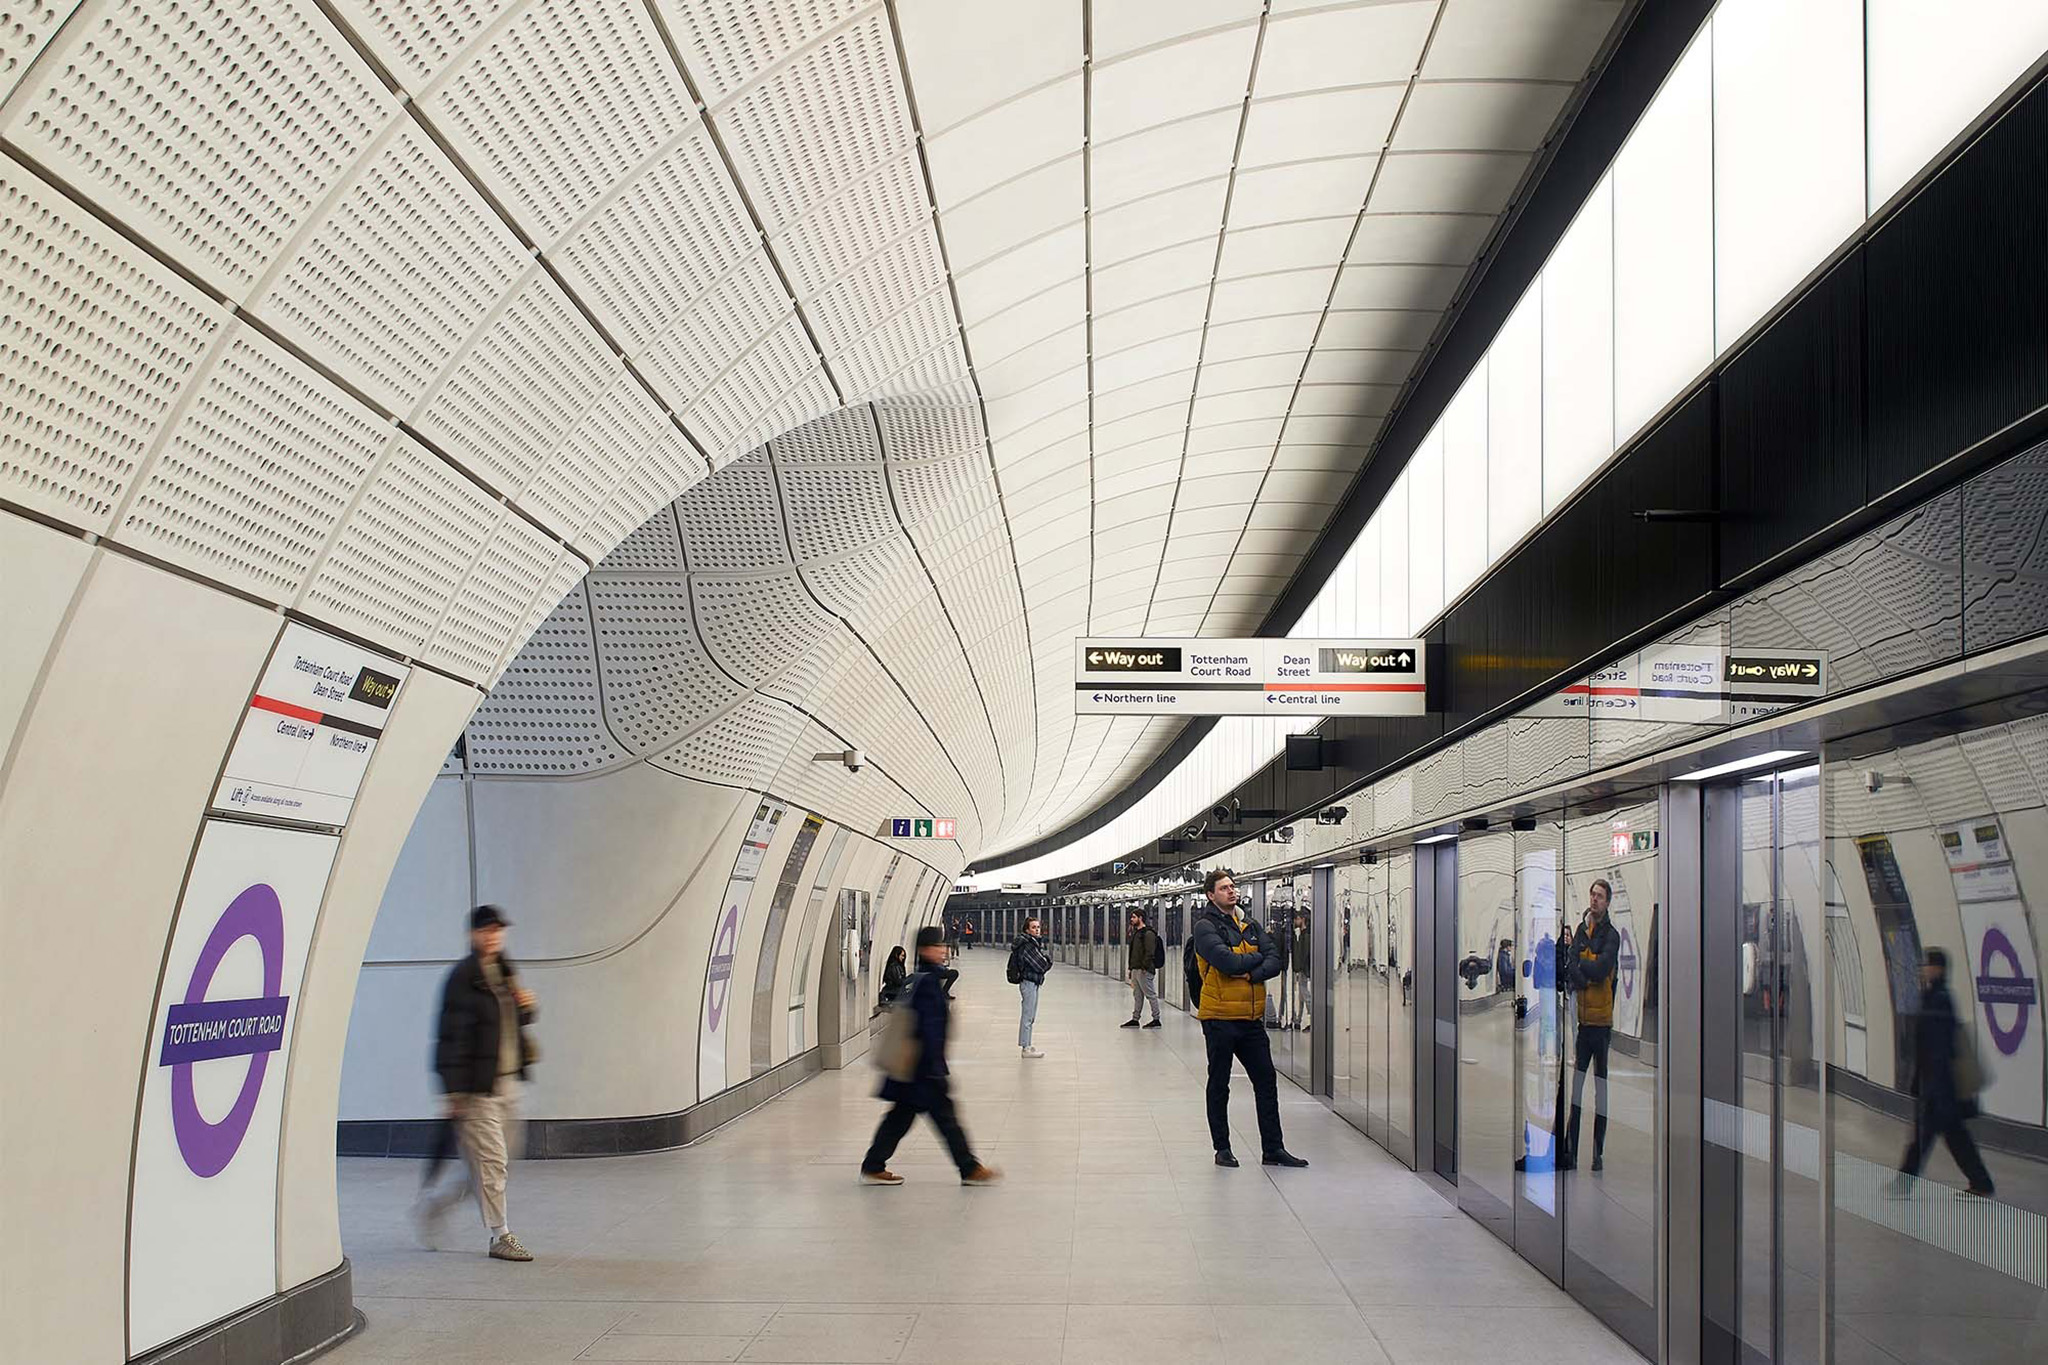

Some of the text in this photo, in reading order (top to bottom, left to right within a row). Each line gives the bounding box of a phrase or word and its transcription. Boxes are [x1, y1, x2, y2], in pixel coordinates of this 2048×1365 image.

[1104, 652, 1164, 667] Way out
[1190, 655, 1249, 666] Tottenham
[1283, 655, 1311, 666] Dean
[1336, 652, 1397, 668] Way out
[293, 656, 353, 686] Tottenham Court Road
[1190, 667, 1252, 677] Court Road
[1277, 667, 1311, 678] Street
[313, 683, 345, 702] Dean Street
[362, 675, 388, 697] Way out
[1104, 693, 1176, 704] Northern line
[1278, 694, 1341, 705] Central line
[277, 721, 309, 740] Central line
[330, 735, 363, 752] Northern line
[230, 788, 244, 802] Lift
[169, 1015, 282, 1045] TOTTENHAM COURT ROAD
